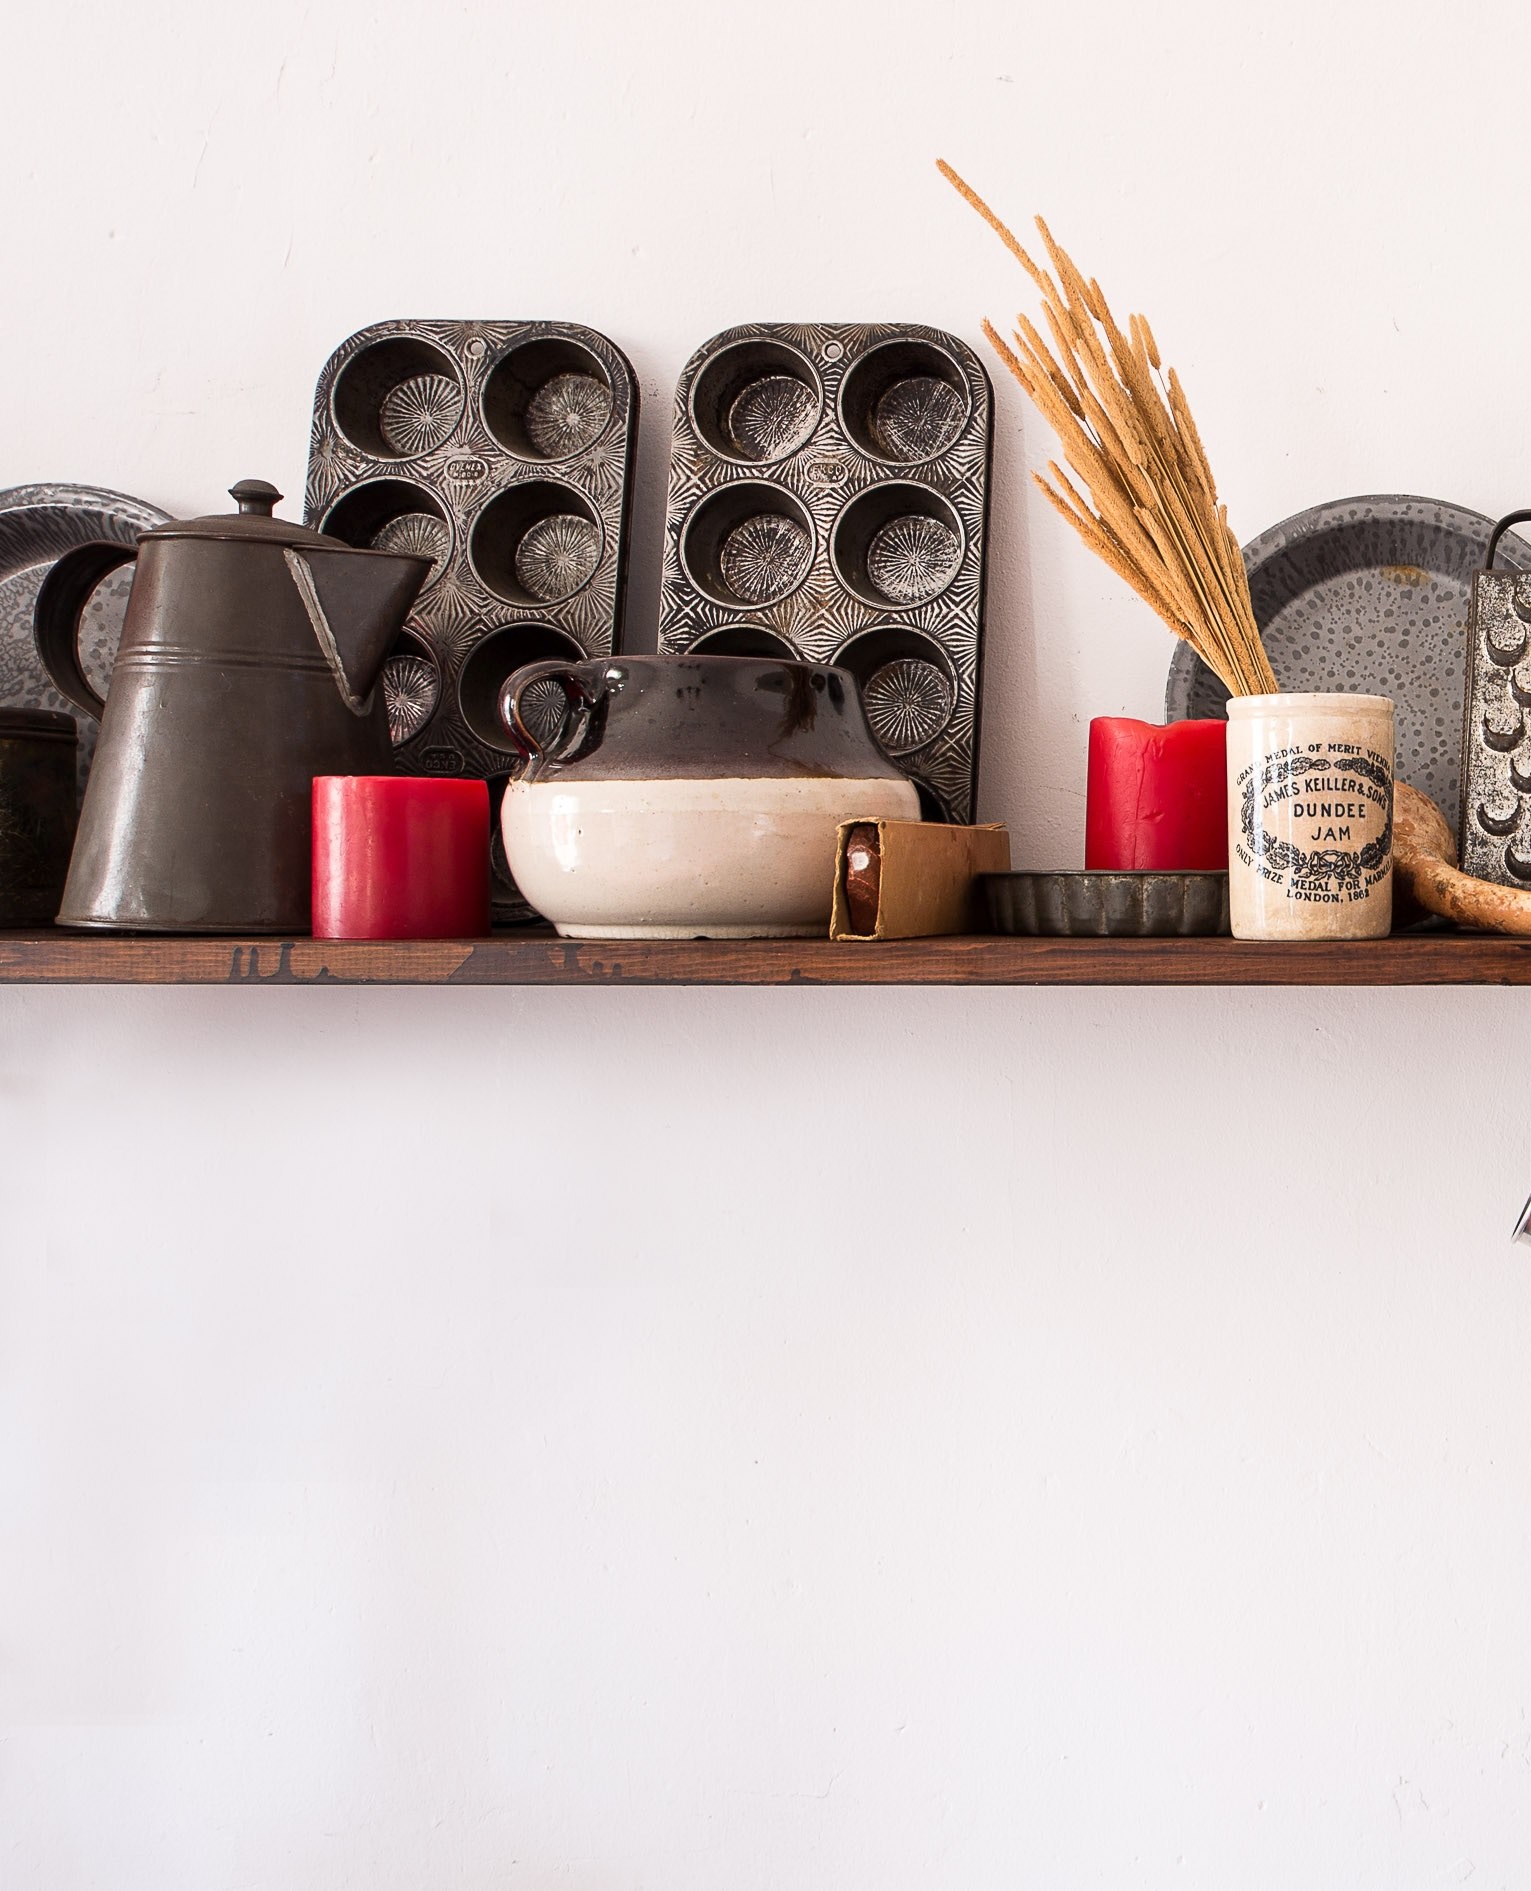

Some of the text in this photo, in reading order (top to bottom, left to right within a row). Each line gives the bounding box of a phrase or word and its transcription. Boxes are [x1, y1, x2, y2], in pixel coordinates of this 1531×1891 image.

[1265, 746, 1303, 763] MEDAL
[1308, 743, 1322, 752] OF
[1328, 743, 1362, 755] MERIT
[1263, 781, 1300, 808] JAMES
[1293, 803, 1366, 818] DUNDEE
[1311, 825, 1351, 841] JAM
[1236, 843, 1254, 867] ONLY
[1256, 863, 1284, 885] PRIZE
[1290, 877, 1332, 892] MEDAL
[1338, 880, 1361, 892] FOR
[1286, 888, 1370, 903] LONDON, 1862
